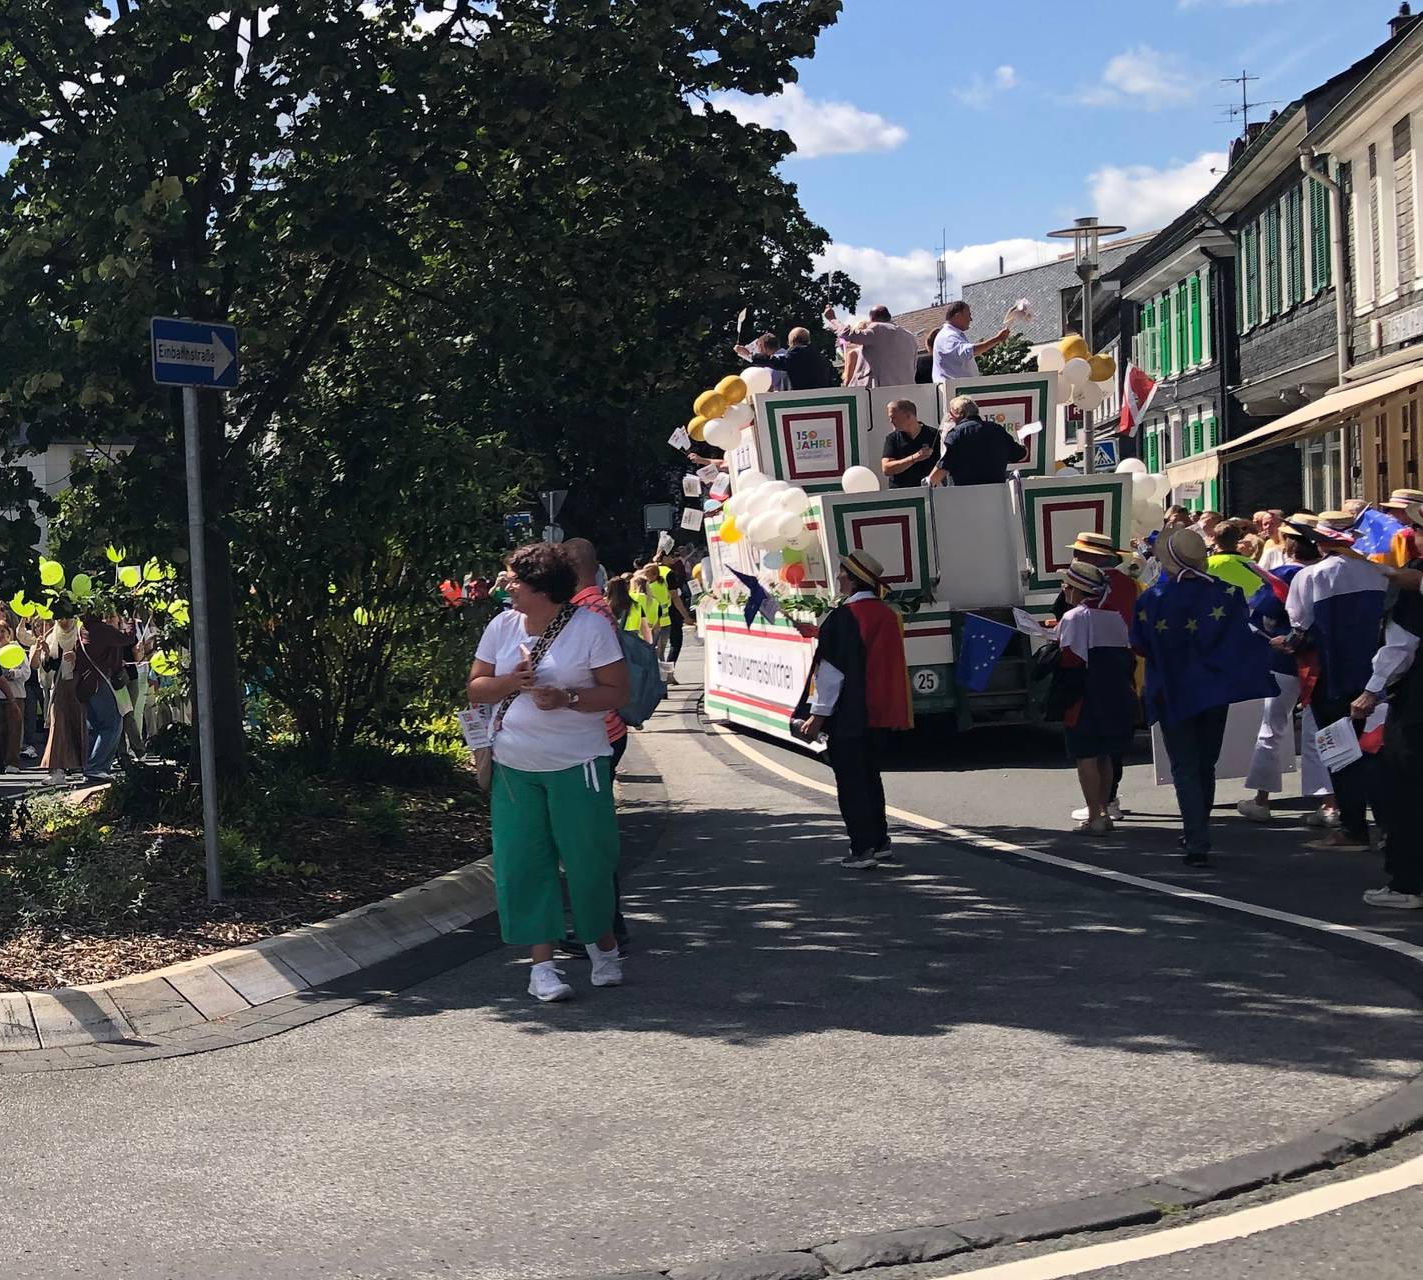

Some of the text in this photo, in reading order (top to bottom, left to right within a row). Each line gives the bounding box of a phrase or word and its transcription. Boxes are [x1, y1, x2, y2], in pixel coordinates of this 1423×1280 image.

[158, 343, 216, 363] Einbahnstraße
[795, 439, 833, 450] JAHRE
[918, 673, 934, 689] 25
